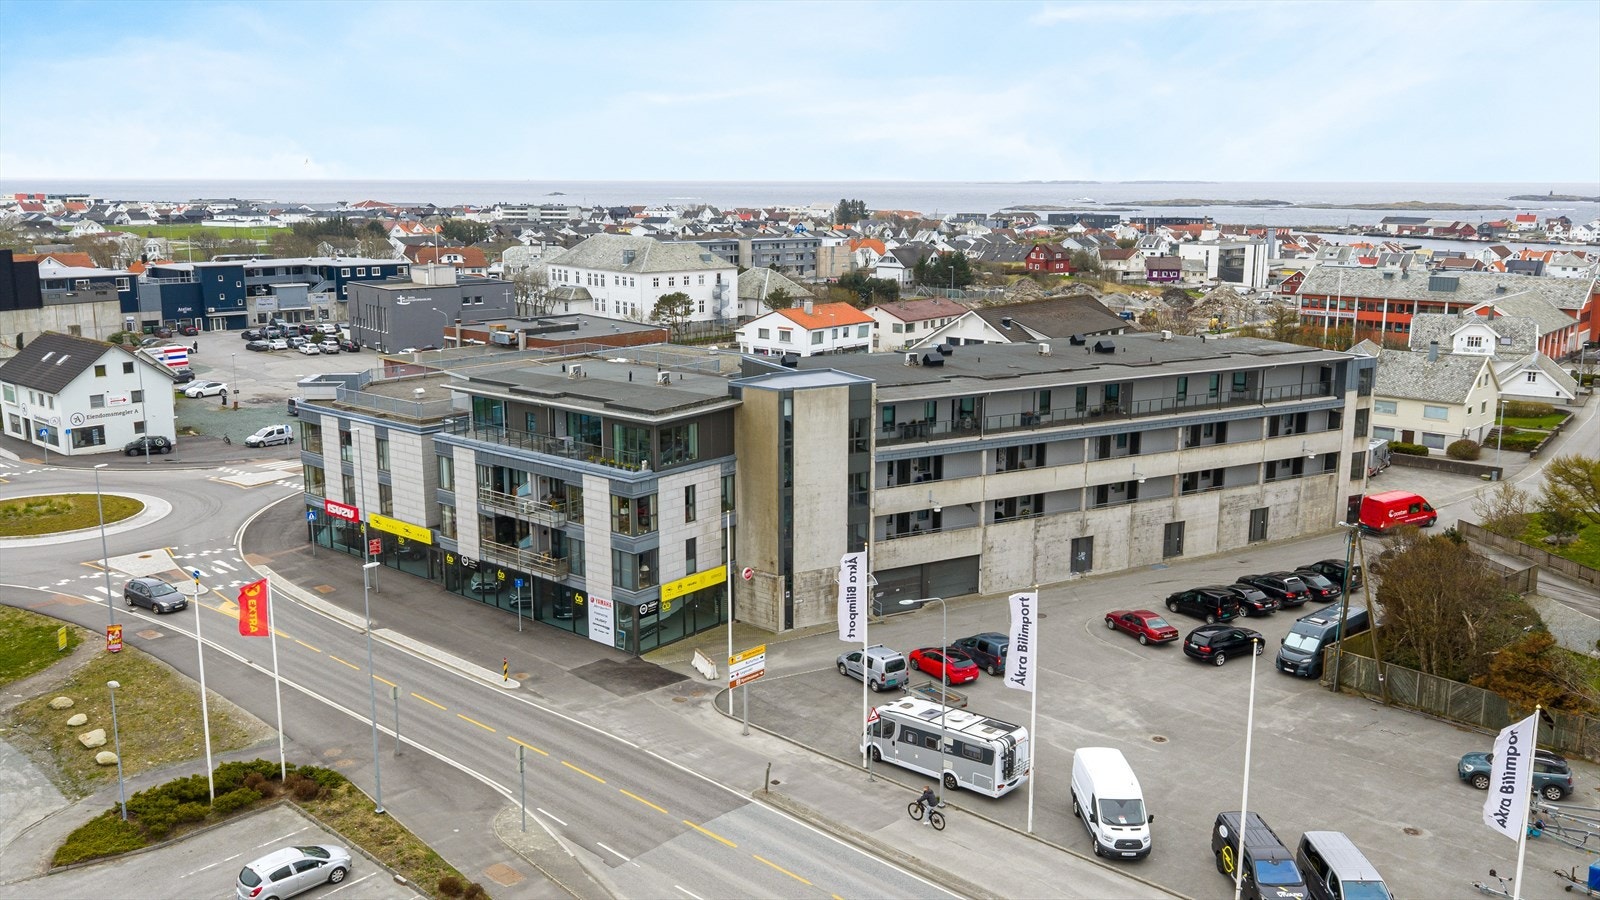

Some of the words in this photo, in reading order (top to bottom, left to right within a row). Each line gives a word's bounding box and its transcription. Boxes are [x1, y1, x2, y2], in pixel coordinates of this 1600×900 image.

[86, 409, 133, 420] Eiendomsmegler
[327, 503, 354, 518] ISUZU
[248, 599, 257, 632] EXTRA
[595, 598, 612, 608] YAMAHA
[1017, 596, 1032, 652] Bilimport
[1010, 656, 1028, 686] Åkra
[1499, 729, 1521, 795] Bilimpor
